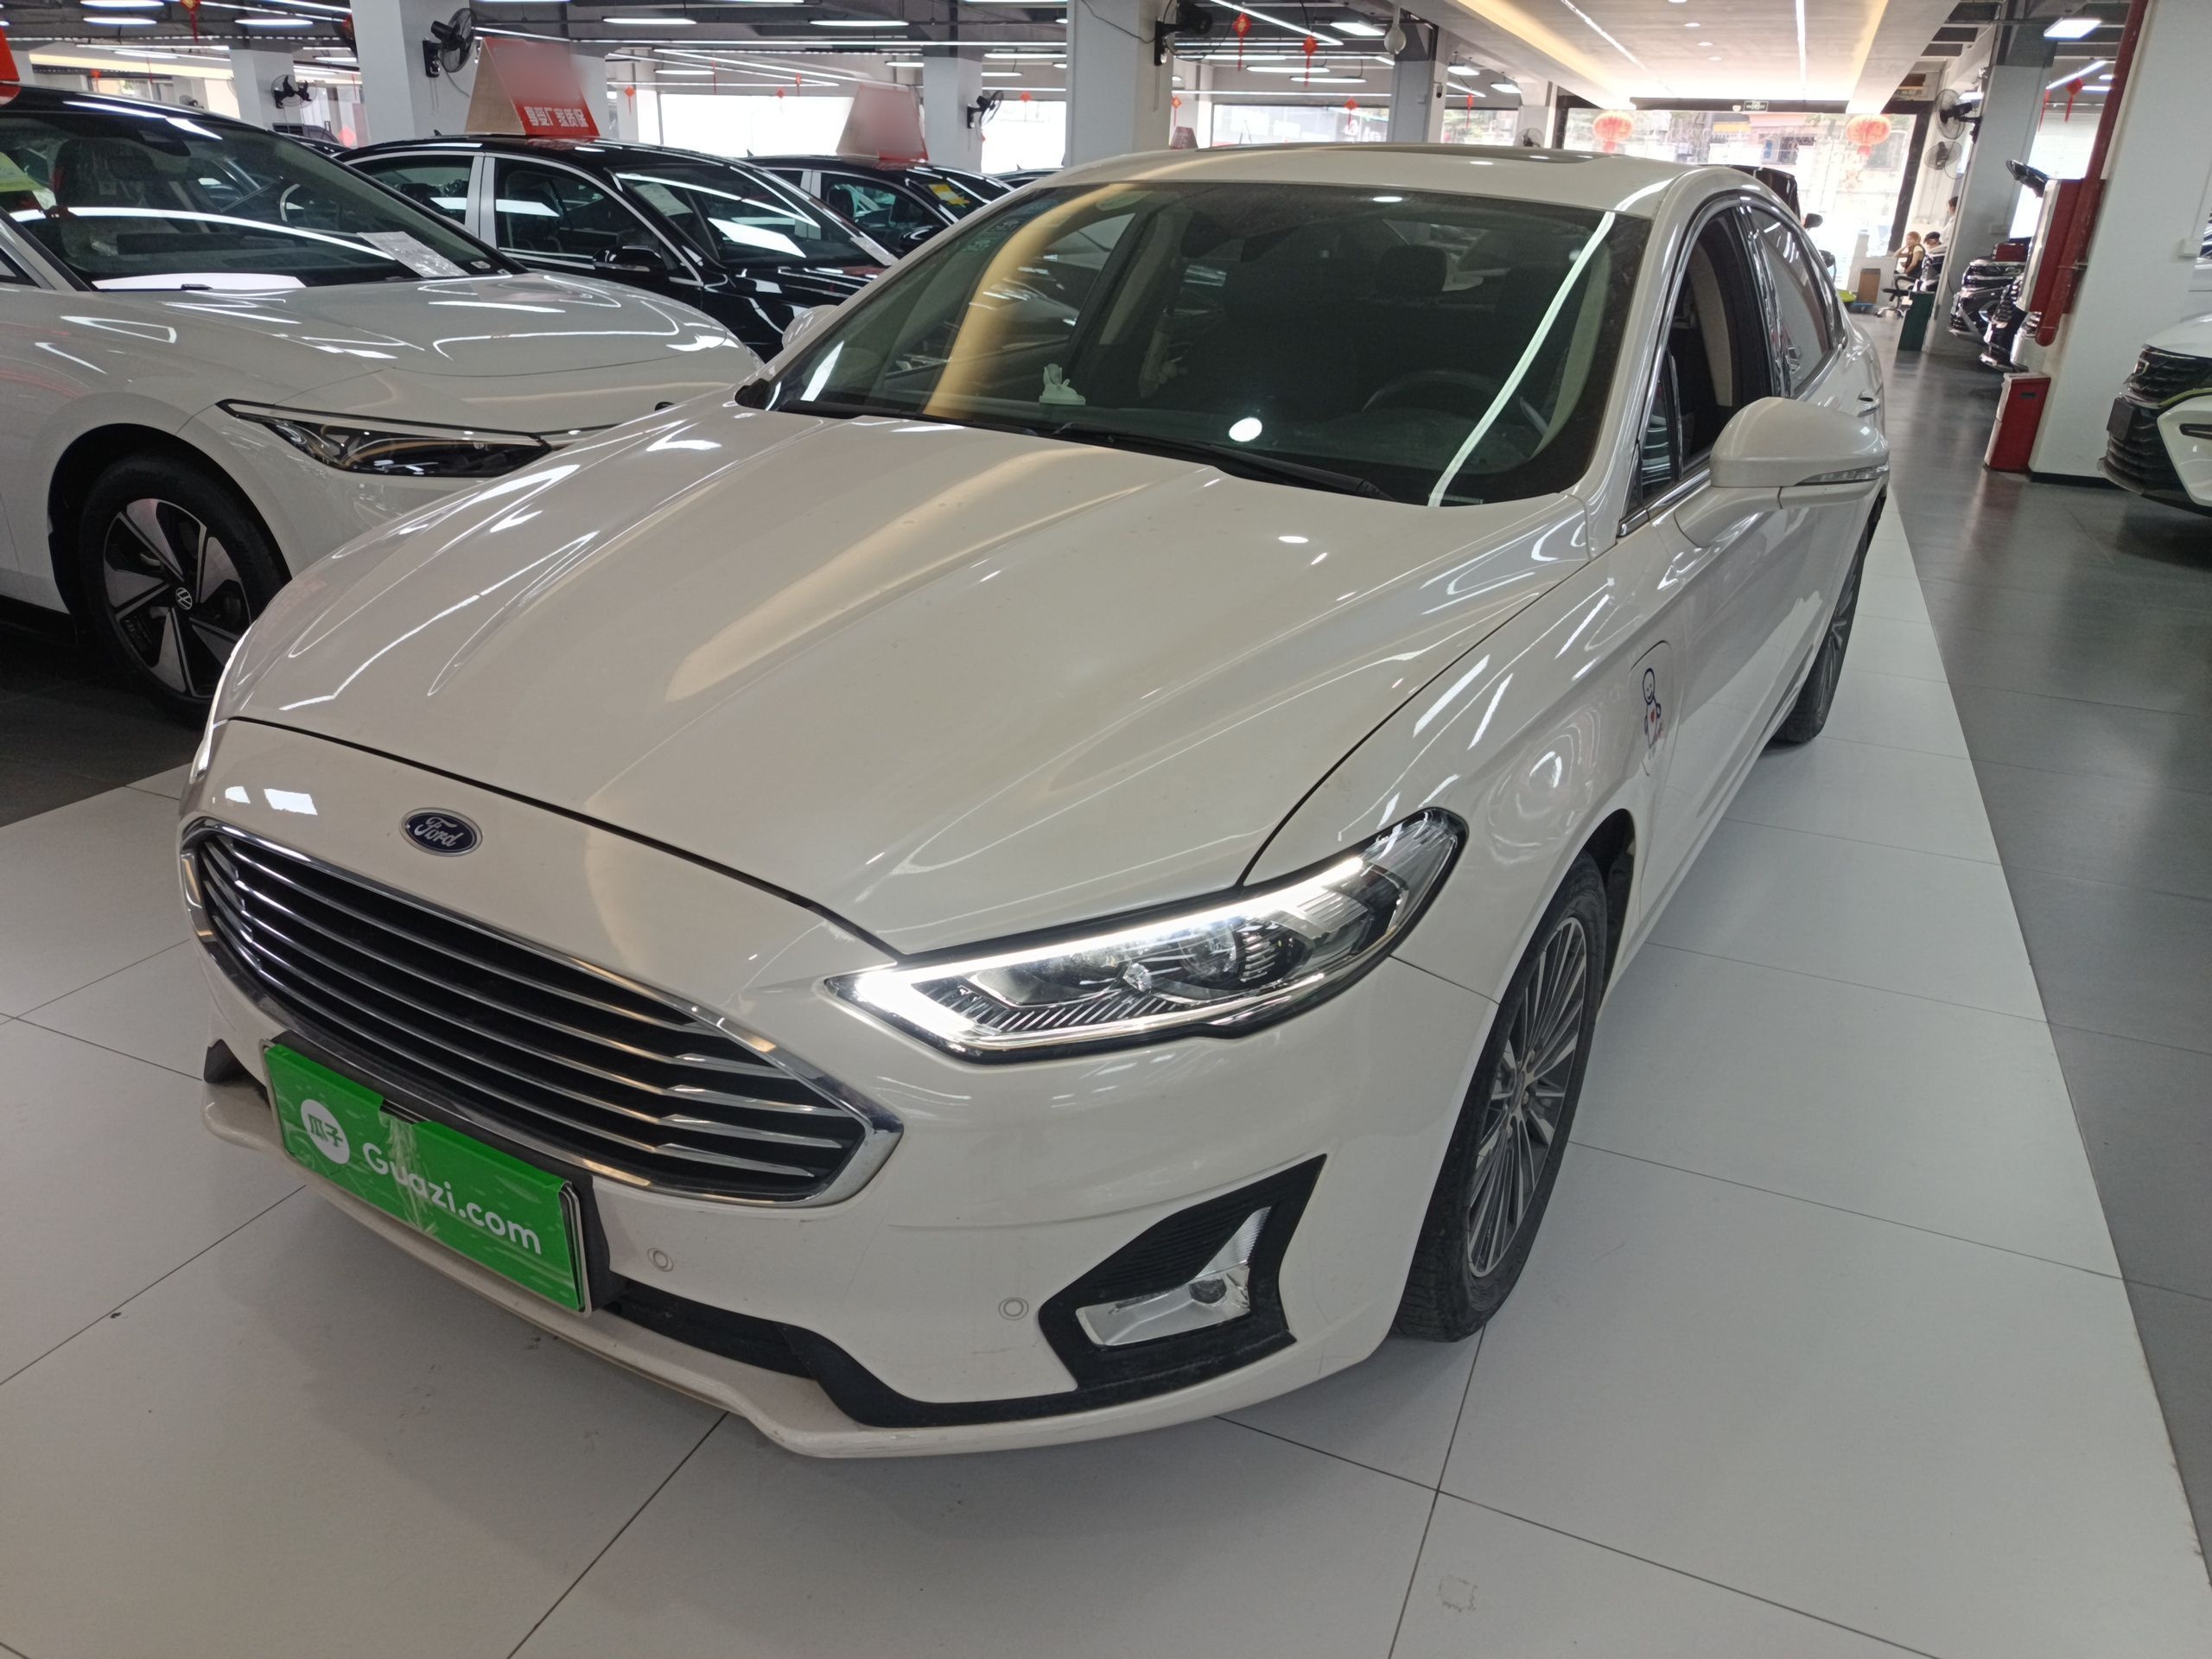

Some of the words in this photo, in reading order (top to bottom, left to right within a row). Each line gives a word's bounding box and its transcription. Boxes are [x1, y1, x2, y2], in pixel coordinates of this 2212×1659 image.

[414, 817, 464, 847] Ford
[307, 1114, 344, 1147] 瓜子
[362, 1142, 542, 1255] Guazi.com
